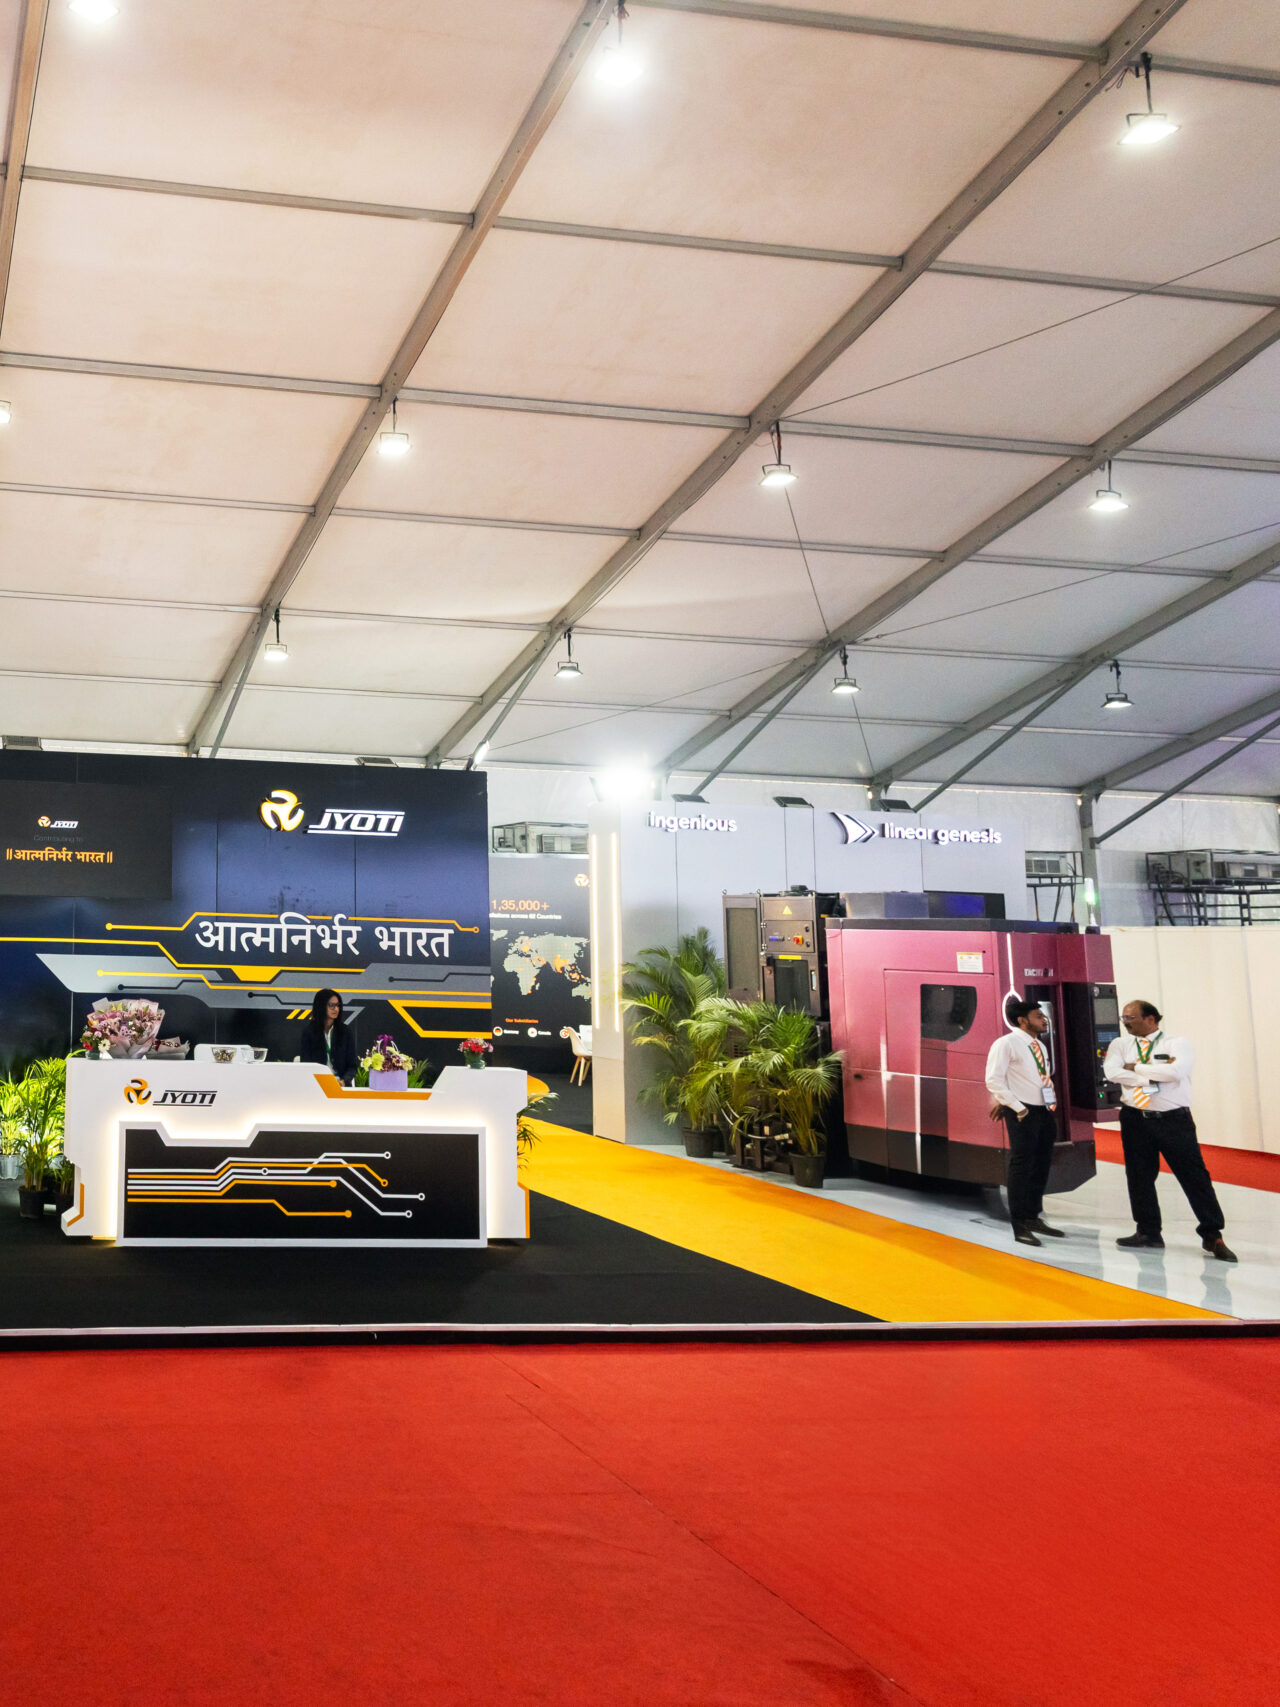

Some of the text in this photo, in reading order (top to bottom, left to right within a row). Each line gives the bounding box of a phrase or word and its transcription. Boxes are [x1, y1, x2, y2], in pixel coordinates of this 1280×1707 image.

[308, 810, 405, 835] JYOTI
[648, 810, 738, 832] ingenious
[882, 822, 1002, 845] linear genesis
[195, 911, 454, 958] आत्मनिर्भर भारत
[153, 1091, 217, 1106] JYOTI
